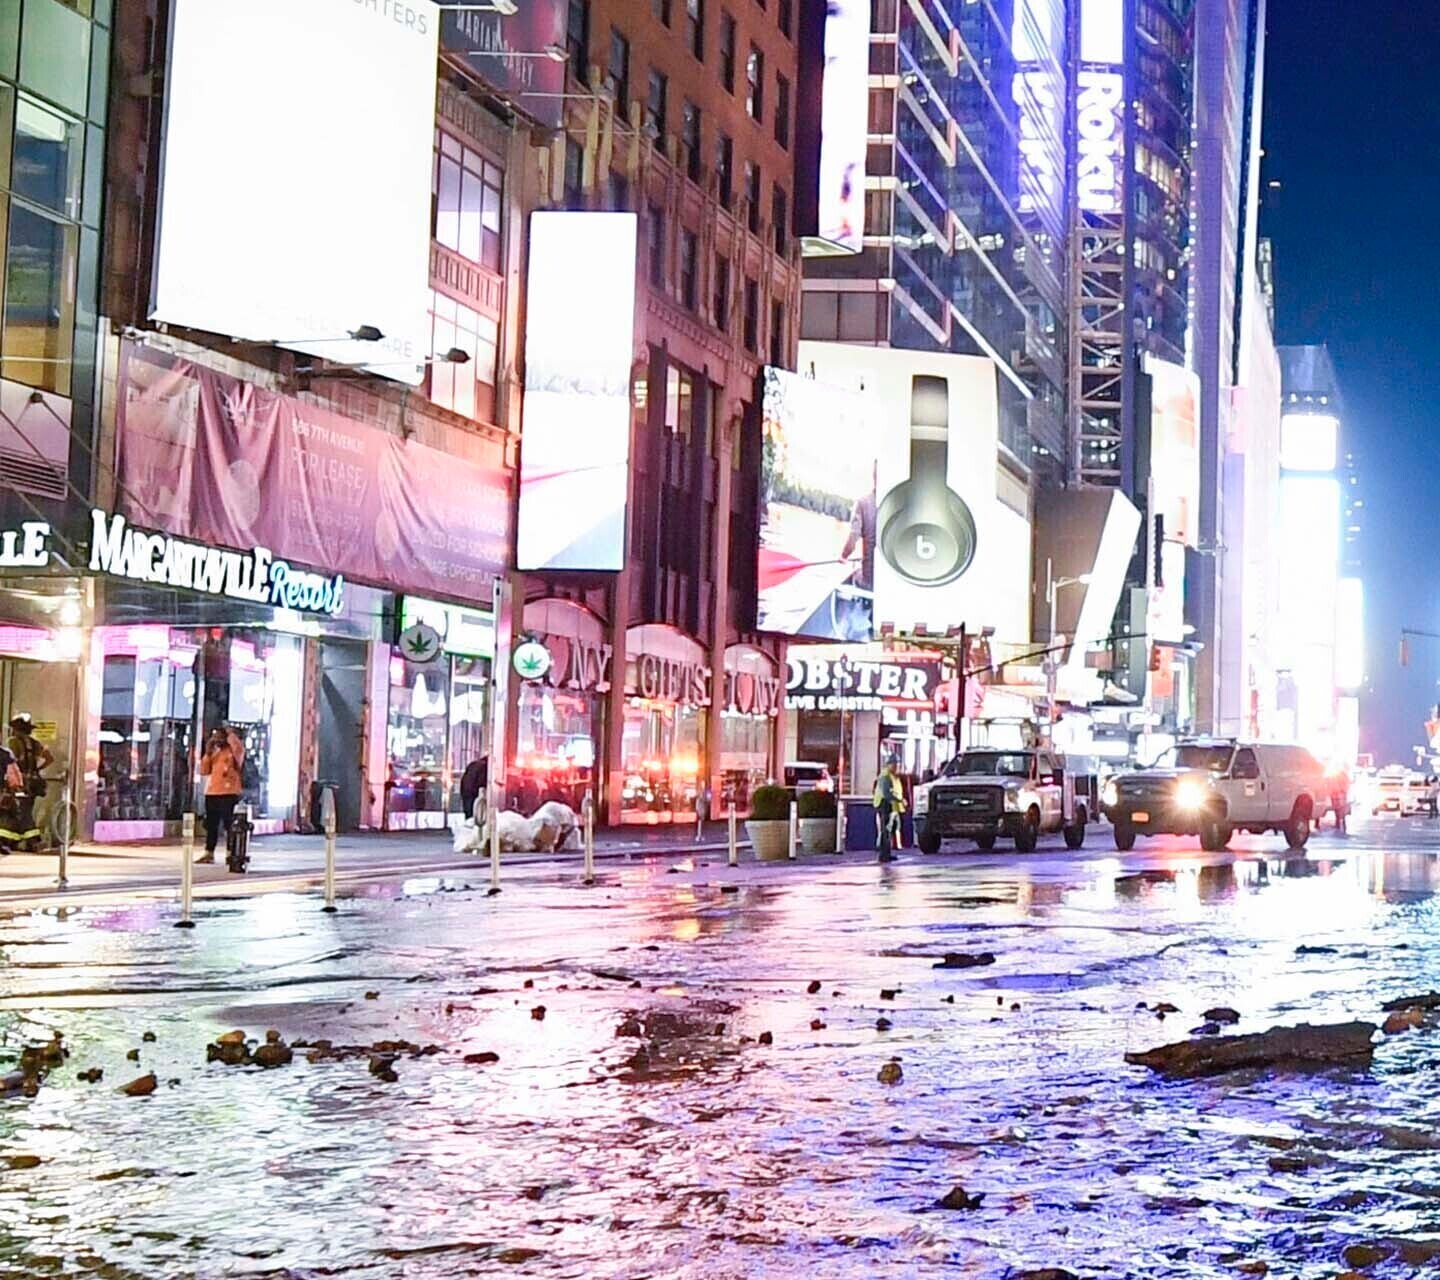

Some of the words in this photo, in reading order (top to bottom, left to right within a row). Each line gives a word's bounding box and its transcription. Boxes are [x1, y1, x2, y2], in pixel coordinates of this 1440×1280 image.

[321, 459, 363, 488] LEASE
[90, 508, 271, 602] MARGARITAVILLE
[271, 560, 344, 617] Resort
[568, 638, 612, 693] NY
[785, 658, 928, 700] OBSTER
[752, 673, 779, 718] NY
[785, 696, 816, 710] LIVE
[818, 697, 881, 711] LOBSTER
